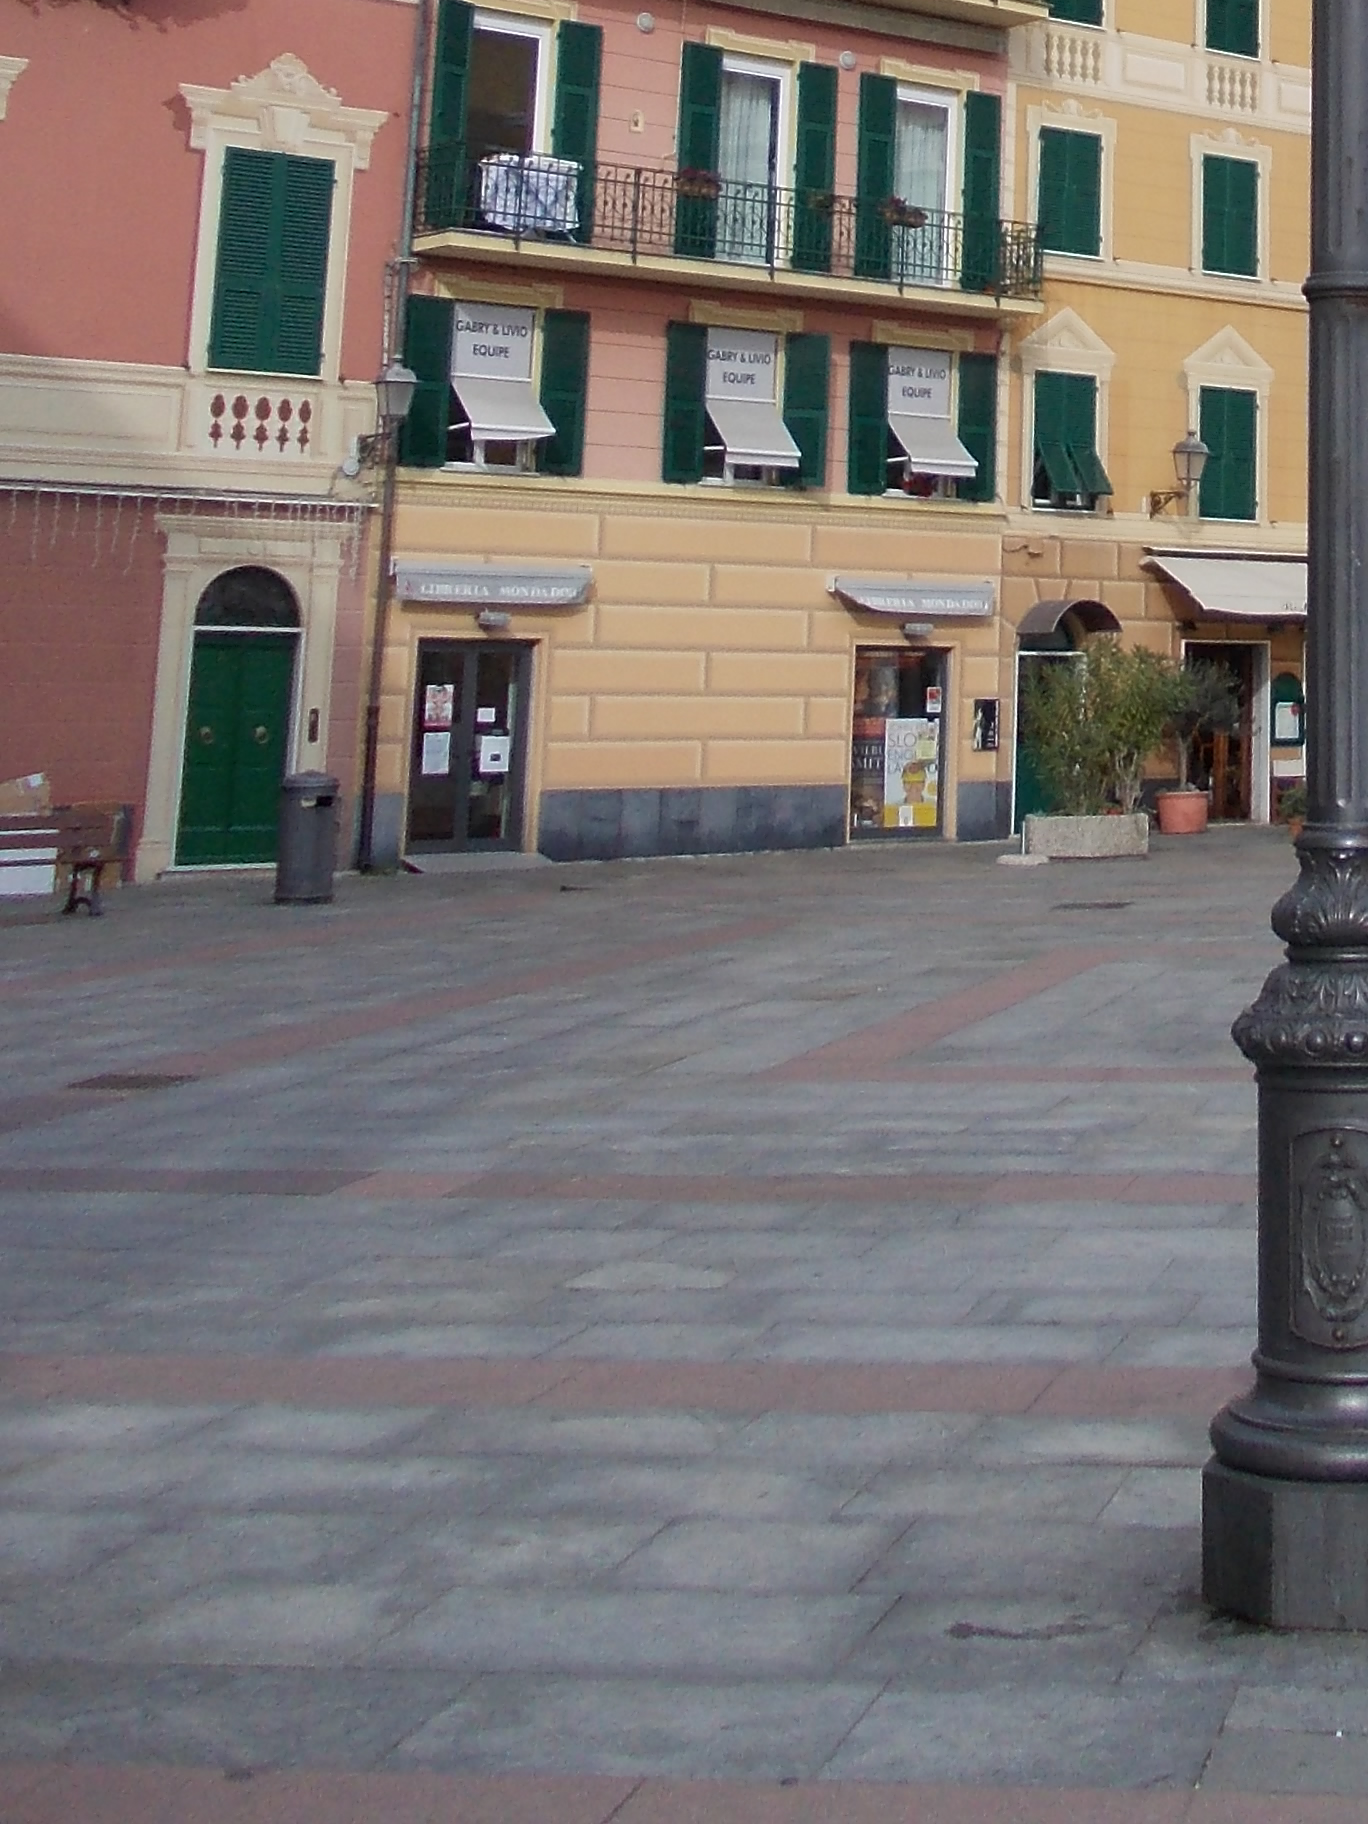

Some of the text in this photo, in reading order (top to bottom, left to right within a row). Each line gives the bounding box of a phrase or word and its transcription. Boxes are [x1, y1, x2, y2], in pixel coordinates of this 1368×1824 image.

[456, 319, 528, 338] GABRY & LIVIO
[472, 343, 511, 359] EQUIPE
[708, 349, 772, 365] GABRY & LIVIO
[722, 371, 756, 385] EQUIPE
[888, 365, 947, 381] GABRY & LIVIO
[901, 385, 933, 399] EQUIPE
[420, 583, 490, 597] LIBRERIA
[887, 732, 918, 748] SLO
